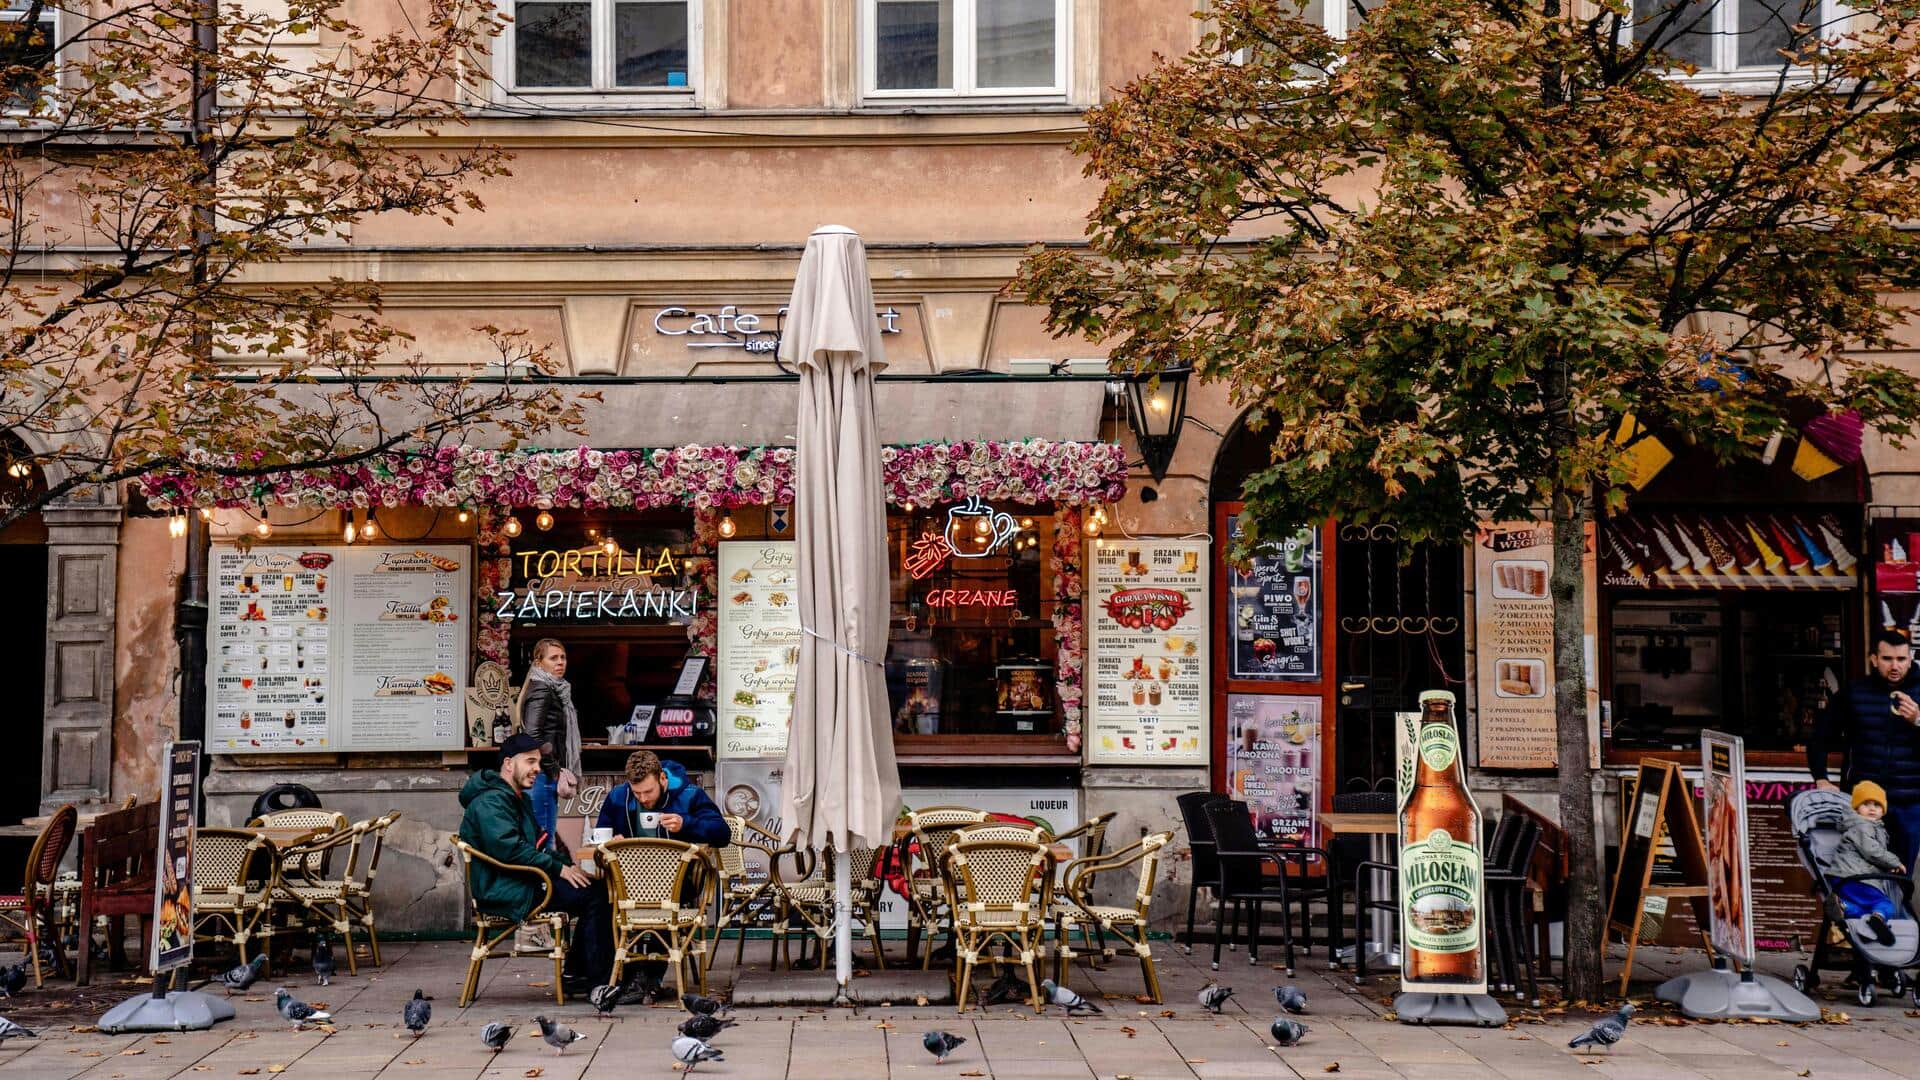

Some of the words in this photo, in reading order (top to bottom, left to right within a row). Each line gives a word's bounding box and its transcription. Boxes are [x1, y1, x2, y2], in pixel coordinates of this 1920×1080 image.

[654, 306, 761, 335] Cafe
[746, 340, 777, 351] since
[760, 547, 793, 564] Gofry
[1098, 549, 1125, 557] GRZANE
[1154, 549, 1181, 557] GRZANE
[255, 555, 293, 568] Napoje
[516, 547, 678, 579] TORTILLA
[1254, 562, 1279, 577] perol
[1256, 572, 1285, 586] Spritz
[1603, 573, 1651, 586] Świderki
[496, 589, 699, 619] ZAPIEKANKI
[926, 589, 1017, 607] GRZANE
[1264, 594, 1293, 602] PIWO
[386, 600, 421, 615] Tortilla
[1254, 615, 1270, 623] Gin
[739, 623, 769, 640] Gofry
[1254, 622, 1279, 630] Tonic
[1280, 628, 1296, 637] SHOT
[1262, 655, 1300, 669] Sangria
[376, 676, 423, 689] Kanapki
[739, 673, 769, 687] Gofry
[661, 709, 693, 723] WINO
[1252, 742, 1281, 751] KAWA
[1265, 766, 1310, 775] SMOOTHIE
[1030, 800, 1068, 810] LIQUEUR
[1272, 819, 1310, 827] GRZANE
[1405, 861, 1477, 891] MIŁOSŁAW
